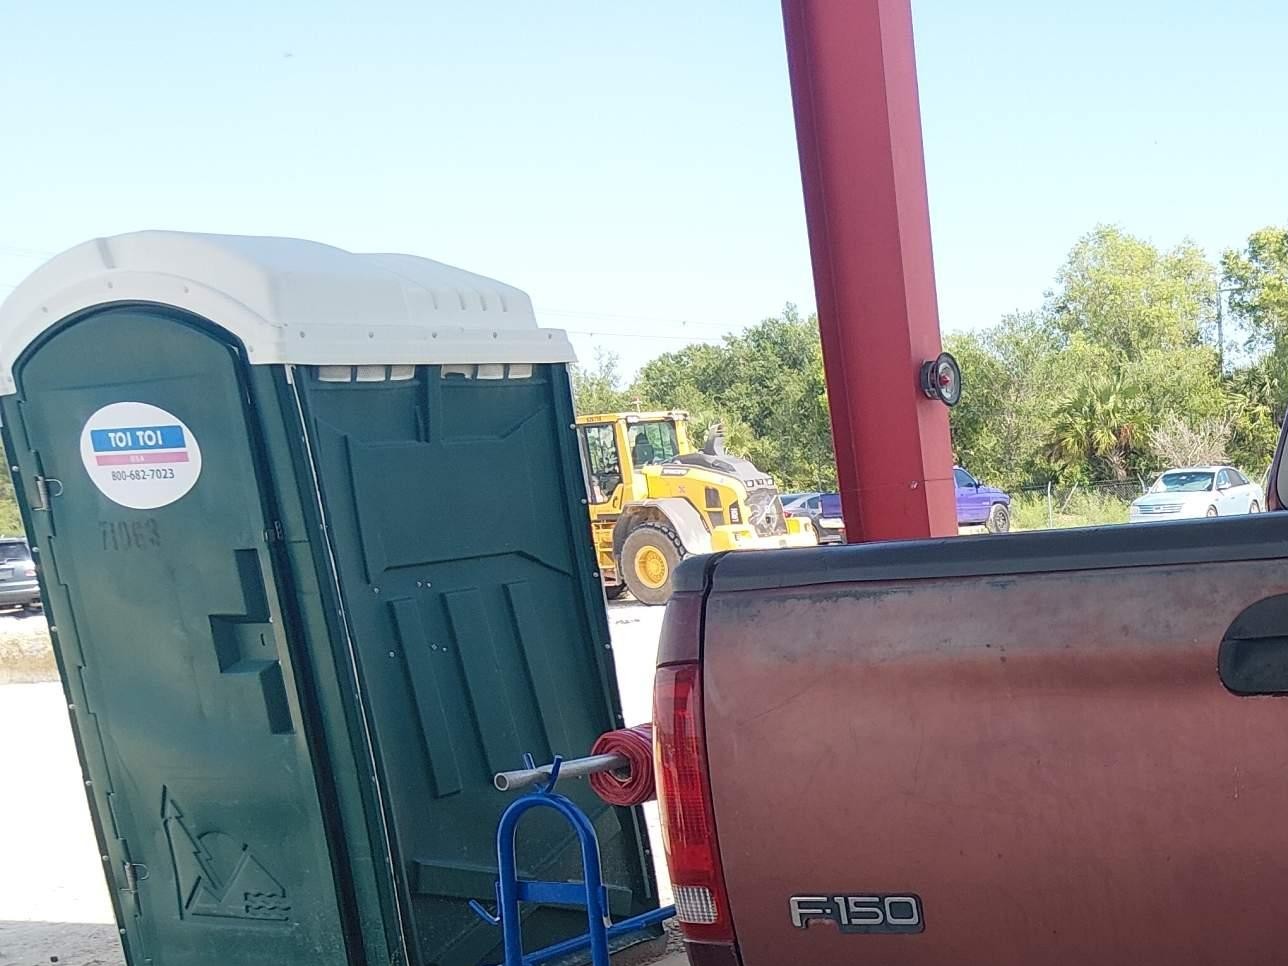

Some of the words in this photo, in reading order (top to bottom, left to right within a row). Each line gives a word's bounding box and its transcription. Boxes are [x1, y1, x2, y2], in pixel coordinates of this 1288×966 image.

[108, 431, 132, 448] TOI
[136, 430, 163, 446] TOI
[111, 468, 175, 481] 800-682-7023
[790, 896, 919, 927] F-150
